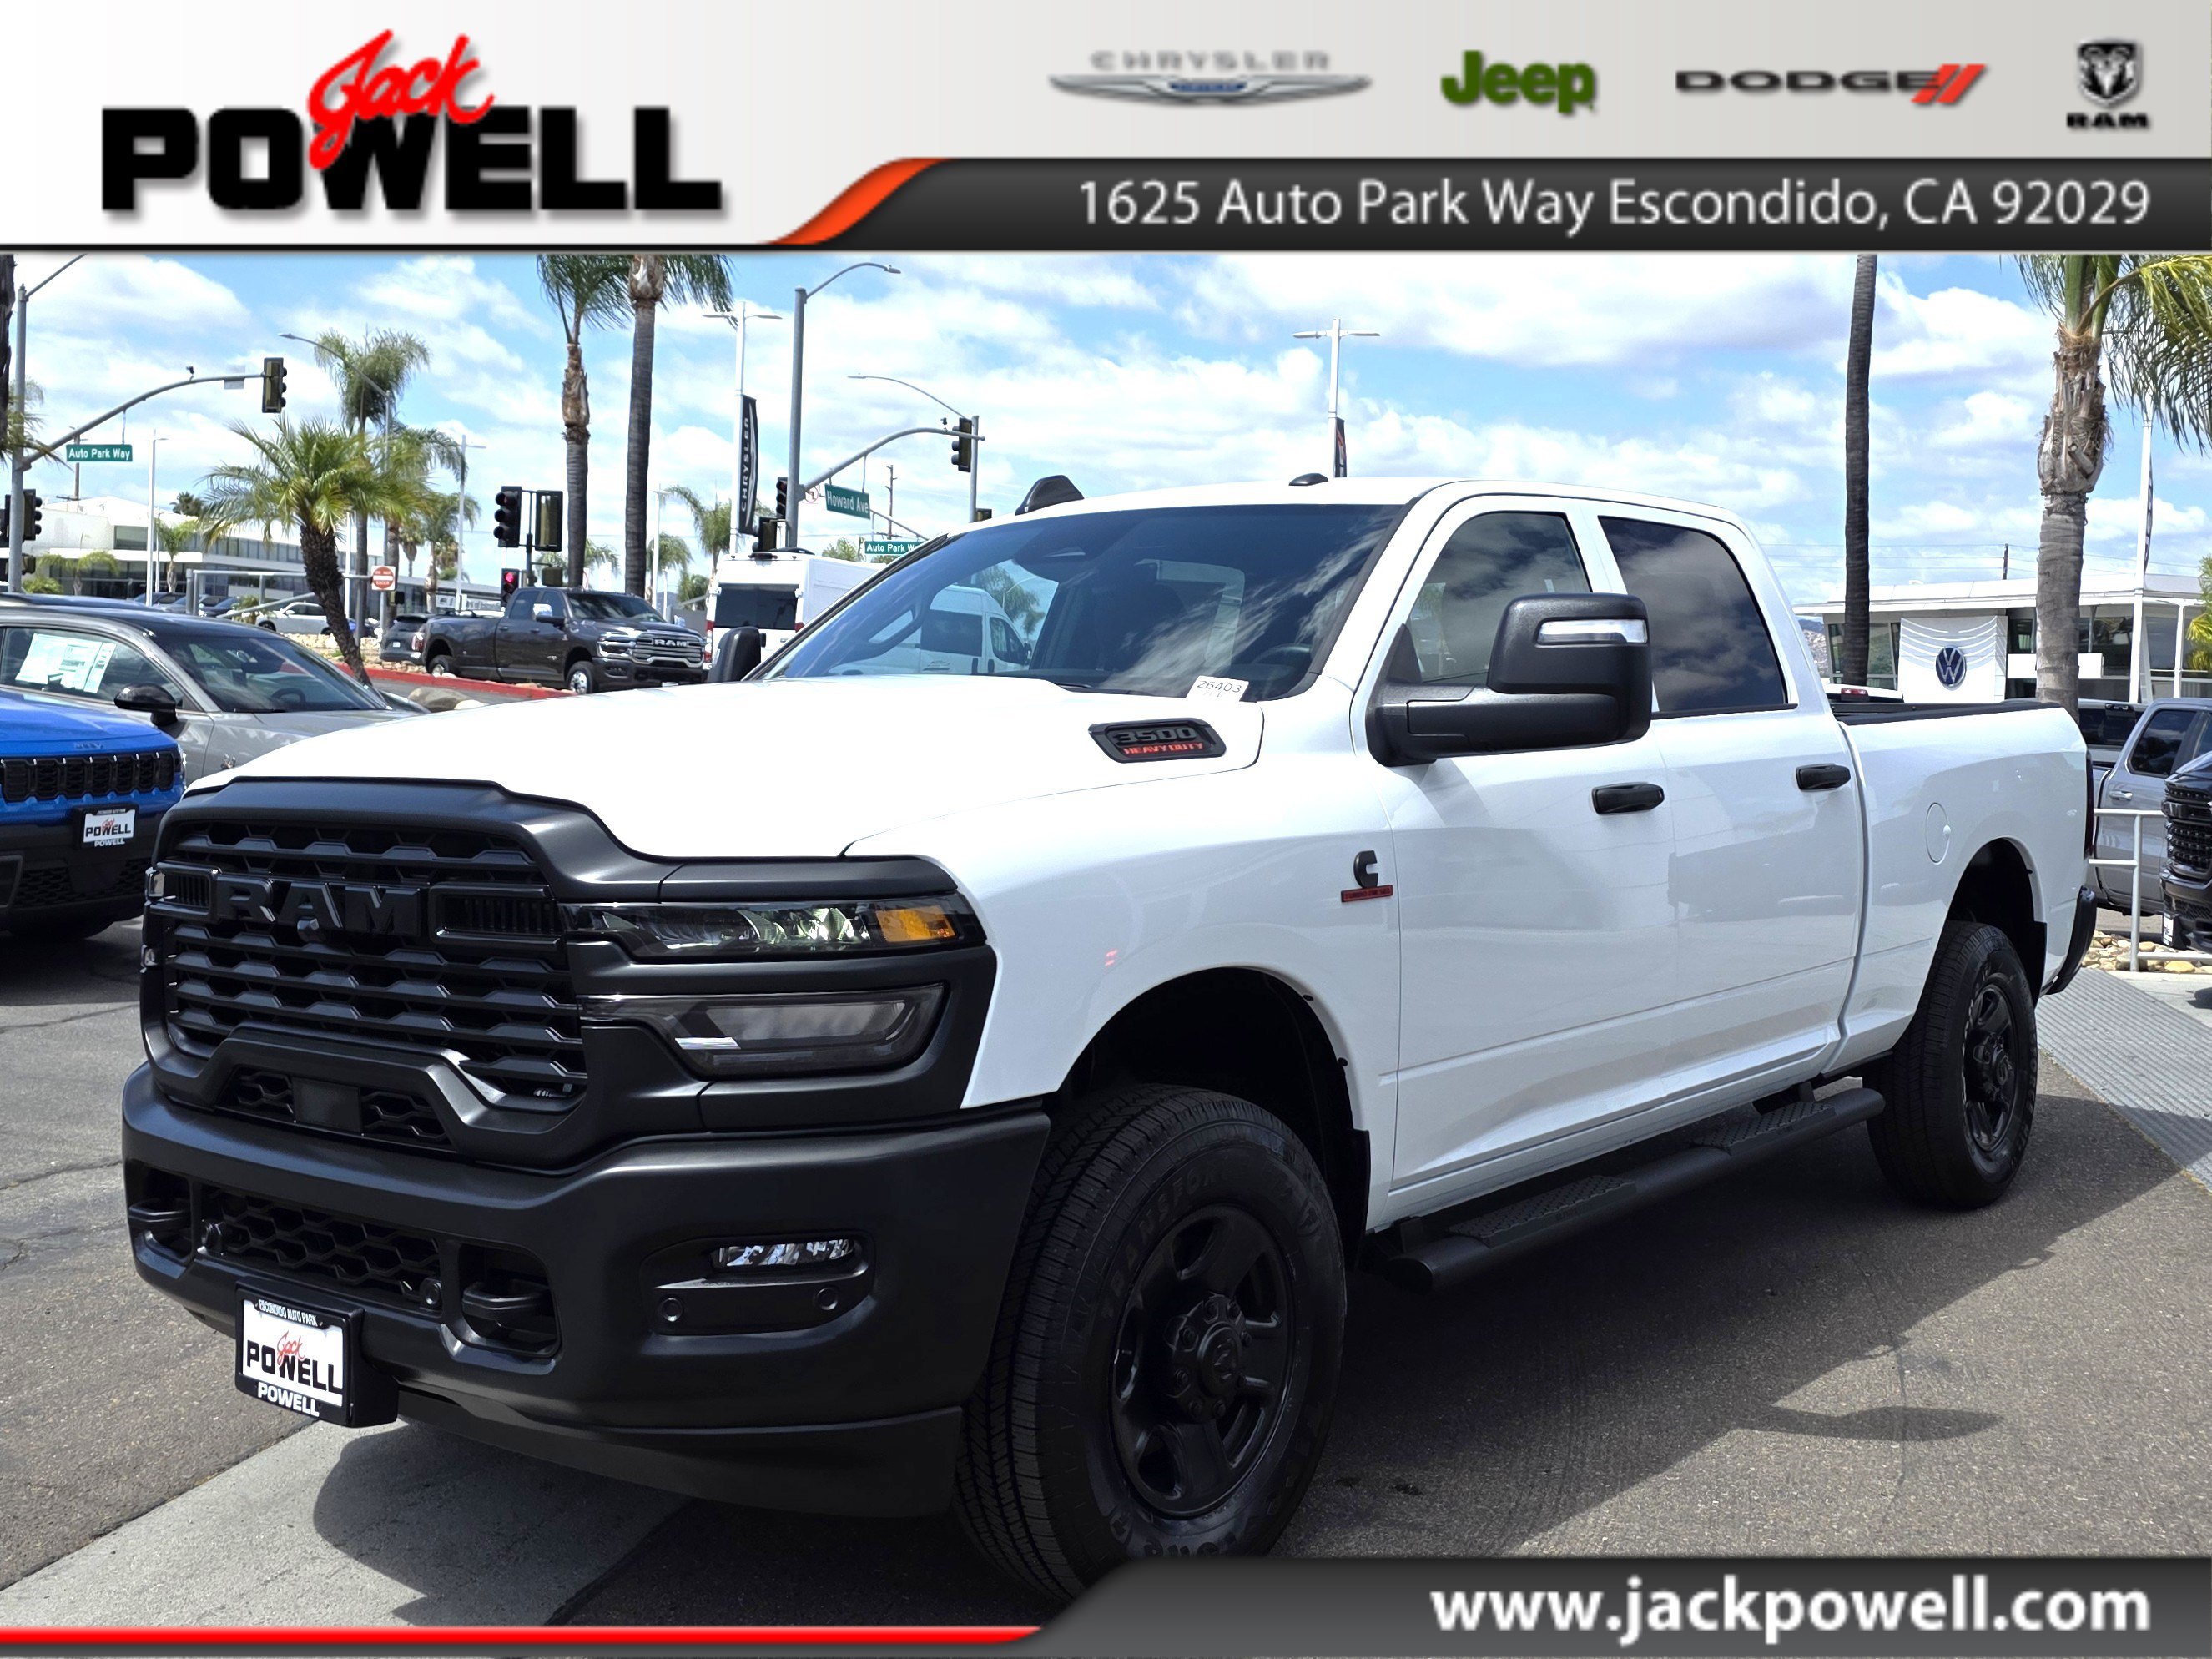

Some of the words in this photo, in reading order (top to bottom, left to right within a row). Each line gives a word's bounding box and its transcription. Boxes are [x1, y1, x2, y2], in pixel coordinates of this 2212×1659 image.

[68, 448, 88, 459] Auto
[91, 448, 111, 459] Park
[113, 448, 130, 461] Way
[741, 417, 750, 512] CHRYSLER
[826, 490, 854, 510] Howard
[856, 497, 869, 514] Ave
[866, 543, 885, 552] Auto
[887, 543, 906, 552] Park
[653, 638, 689, 648] RAM
[1196, 680, 1242, 693] 26403
[1113, 726, 1198, 747] 3500
[1122, 744, 1168, 755] HEAVY
[1168, 742, 1204, 753] DUTY
[85, 823, 132, 838] POWELL
[93, 837, 126, 848] POWELL
[215, 875, 421, 937] RAM
[258, 1298, 287, 1319] ESCONDIDO
[287, 1308, 302, 1324] AUTO
[302, 1312, 319, 1327] PARK
[277, 1330, 305, 1366] Jack
[247, 1339, 343, 1396] POWELL
[257, 1381, 320, 1418] POWELL
